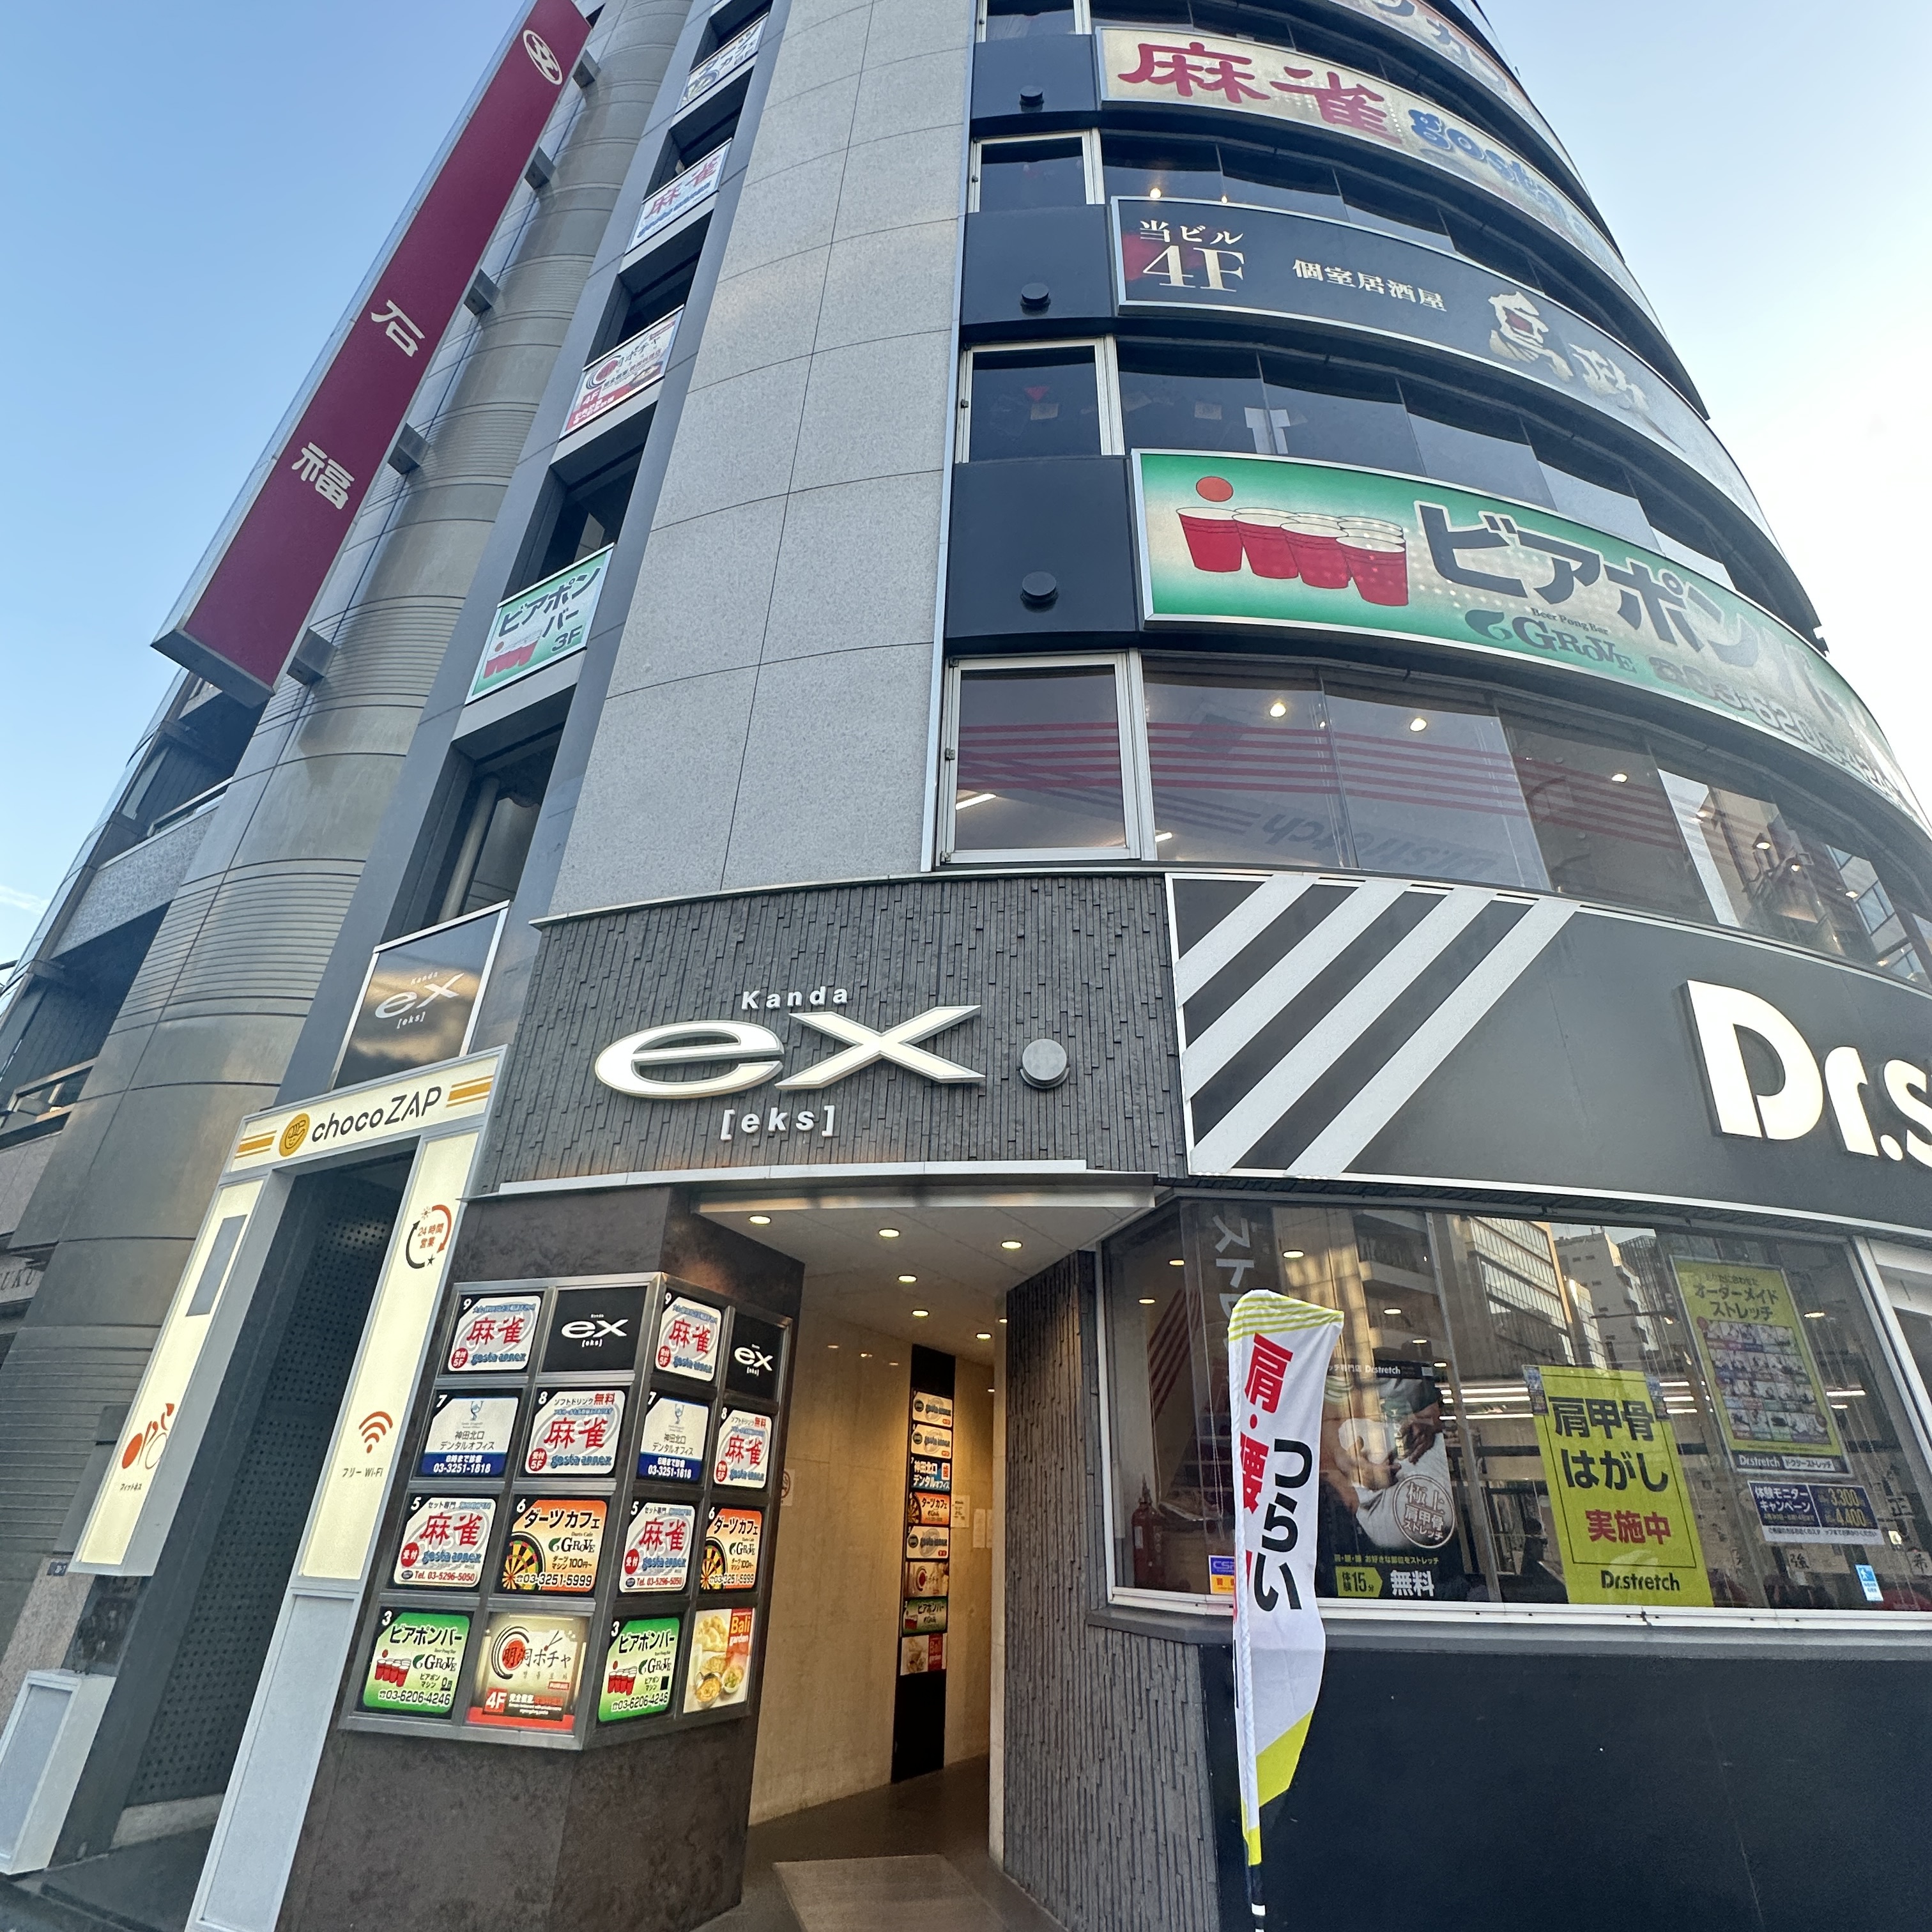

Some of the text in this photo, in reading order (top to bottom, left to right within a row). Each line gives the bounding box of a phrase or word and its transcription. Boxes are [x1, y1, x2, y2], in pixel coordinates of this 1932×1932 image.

[1117, 42, 1403, 145] 麻雀
[643, 155, 721, 220] 麻雀
[1140, 219, 1243, 245] 当ビル
[1142, 245, 1245, 292] 4F
[1292, 258, 1448, 312] 個室居酒屋
[498, 567, 601, 638] ビアポン
[542, 607, 579, 638] バー
[1531, 607, 1609, 635] Beer Pong Bar
[551, 624, 583, 652] 3F
[410, 971, 439, 985] Kanda
[375, 972, 464, 1019] ex
[740, 986, 849, 1011] Kanda
[395, 1012, 426, 1029] [eks]
[594, 1004, 987, 1100] ex
[311, 1085, 443, 1143] chocoZAP
[720, 1104, 835, 1141] [eks]
[665, 1292, 672, 1305] 9
[1692, 1282, 1779, 1305] オーダーメイド
[463, 1298, 472, 1310] 9
[1710, 1301, 1774, 1321] ストレッチ
[466, 1314, 525, 1346] 麻雀
[561, 1319, 629, 1338] ex
[668, 1318, 711, 1354] 麻雀
[452, 1358, 464, 1367] 5F
[734, 1347, 774, 1372] ex
[1365, 1365, 1401, 1374] Dr.stretch
[436, 1394, 448, 1407] 7
[538, 1391, 548, 1405] 8
[554, 1393, 616, 1406] ソフトドリンク無料
[647, 1391, 657, 1406] 7
[1548, 1395, 1655, 1442] 肩甲骨
[454, 1430, 486, 1441] 神田北口
[543, 1416, 608, 1450] 麻雀
[439, 1441, 495, 1451] デンタルオフィス
[652, 1441, 694, 1456] デンタルオフィス
[724, 1434, 763, 1466] 麻雀
[433, 1463, 491, 1474] 03-3251-1818
[530, 1460, 544, 1469] 5F
[550, 1453, 613, 1469] gosta annex
[1561, 1448, 1669, 1492] はがし
[1738, 1454, 1781, 1468] Dr.stretch
[342, 1468, 362, 1478] フリー
[647, 1464, 692, 1479] 03-3251-1818
[1407, 1482, 1445, 1514] 極上
[1755, 1485, 1809, 1499] 体験モニター
[410, 1496, 422, 1511] 5
[516, 1498, 526, 1514] 6
[630, 1501, 640, 1515] 5
[708, 1506, 716, 1520] 6
[1760, 1500, 1811, 1513] キャンペーン
[524, 1508, 601, 1529] ダーツカフェ
[714, 1517, 758, 1535] ダーツカフェ
[1254, 1438, 1314, 1613] つらい
[1405, 1505, 1444, 1531] 肩甲骨
[1584, 1508, 1672, 1545] 実施中
[418, 1512, 484, 1546] 麻雀
[639, 1517, 687, 1552] 麻雀
[1403, 1521, 1444, 1541] ストレッチ
[422, 1549, 482, 1565] gosta annex
[415, 1571, 475, 1582] Tel. 03-5296-5050
[1390, 1569, 1435, 1597] 無料
[1600, 1569, 1681, 1591] Dr.stretch
[381, 1610, 392, 1626] 3
[730, 1615, 751, 1634] Bali
[389, 1625, 463, 1646] ビアポンバー
[611, 1620, 620, 1637] 3
[618, 1630, 675, 1653] ビアポンバー
[729, 1633, 749, 1646] garden
[419, 1673, 441, 1682] ビアポン
[421, 1680, 437, 1689] マシン
[486, 1691, 507, 1710] 4F
